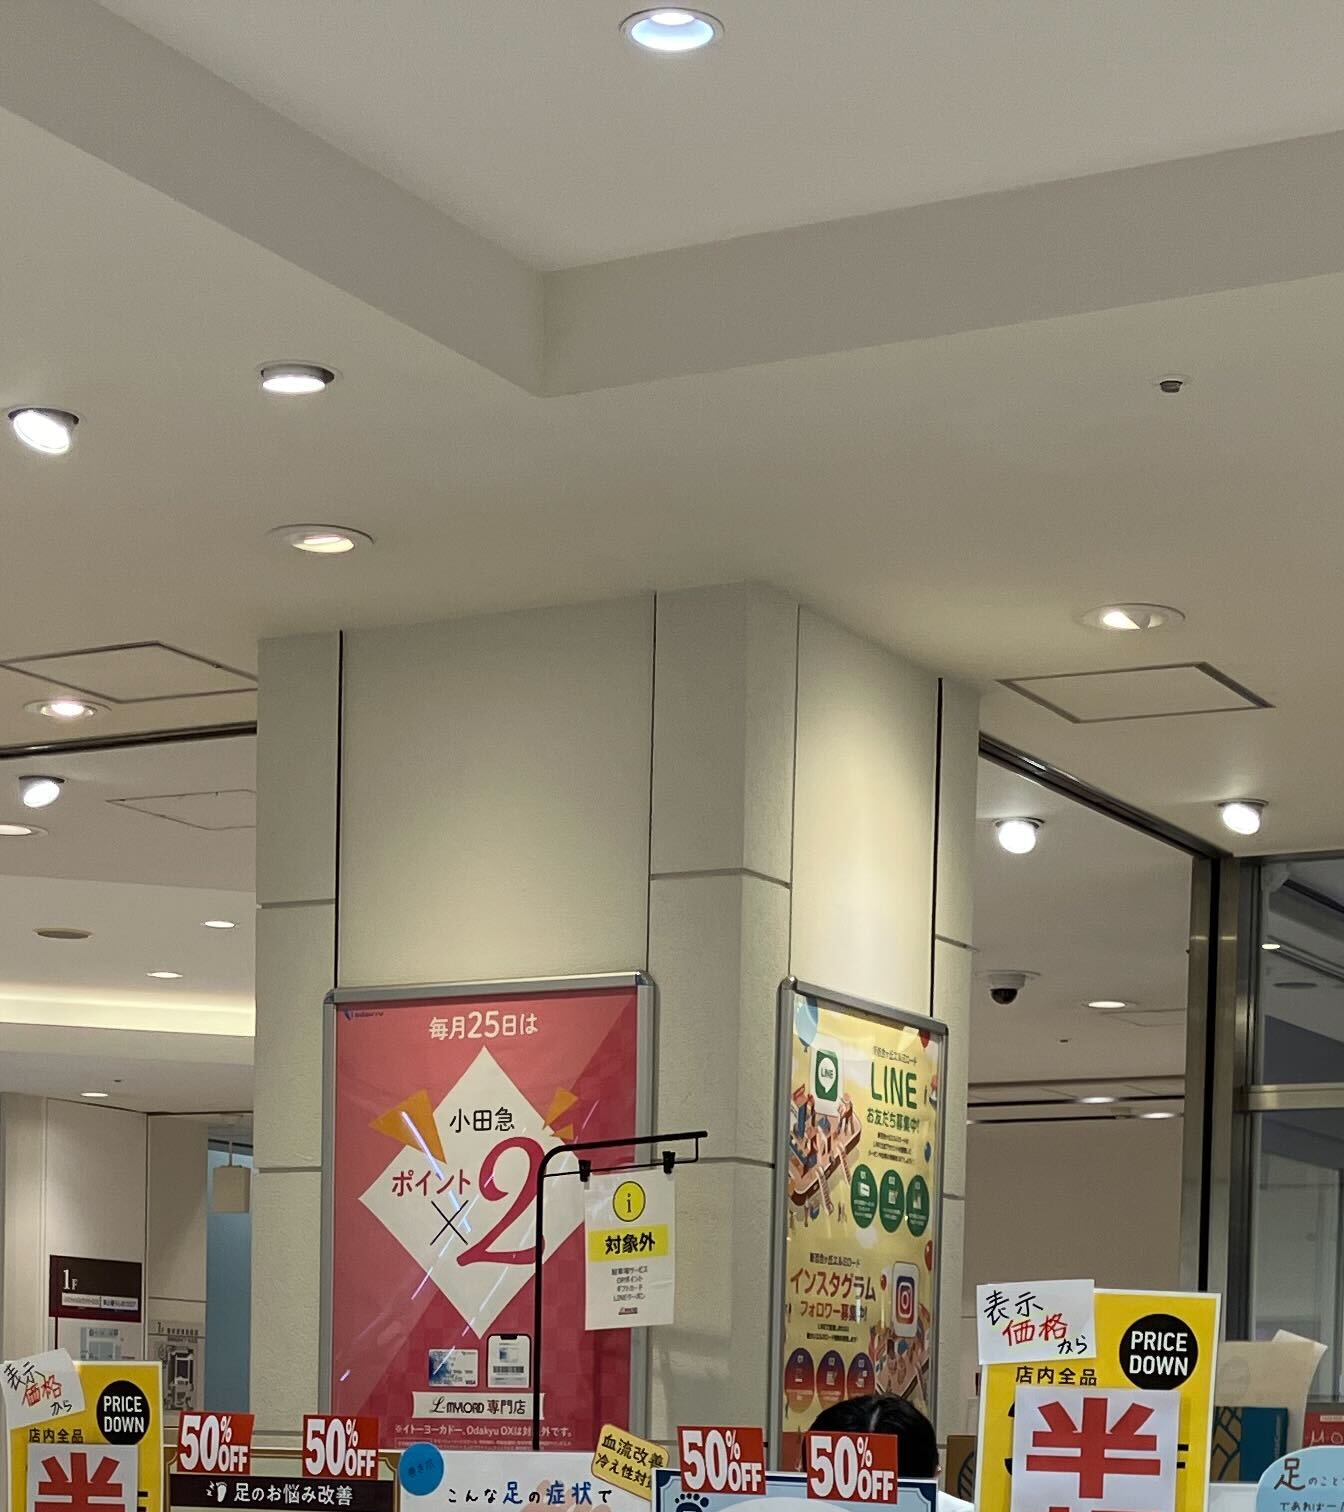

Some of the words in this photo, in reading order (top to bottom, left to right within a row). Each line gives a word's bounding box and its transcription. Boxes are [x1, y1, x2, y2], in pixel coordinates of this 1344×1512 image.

[429, 1010, 538, 1041] 毎月25日は
[871, 1062, 917, 1109] LINE
[450, 1107, 515, 1132] 小田急
[392, 1169, 471, 1196] ポイント
[605, 1231, 655, 1254] 対象外
[790, 1267, 876, 1302] インスタグラム
[984, 1290, 1043, 1326] 表示
[1002, 1313, 1069, 1346] 価格
[1131, 1331, 1188, 1352] PRICE
[1058, 1336, 1087, 1354] から
[1016, 1366, 1098, 1387] 店内全品
[1130, 1355, 1188, 1376] DOWN
[22, 1375, 63, 1405] 価格
[51, 1401, 73, 1416] から
[103, 1396, 142, 1413] PRICE
[488, 1399, 526, 1415] 専門店
[29, 1427, 84, 1443] 店内全品
[103, 1416, 144, 1433] DOWN
[219, 1445, 248, 1472] OFF
[601, 1434, 664, 1468] 血流改善
[235, 1483, 352, 1507] 足のお悩み改善
[448, 1480, 612, 1504] こんな足の症状で
